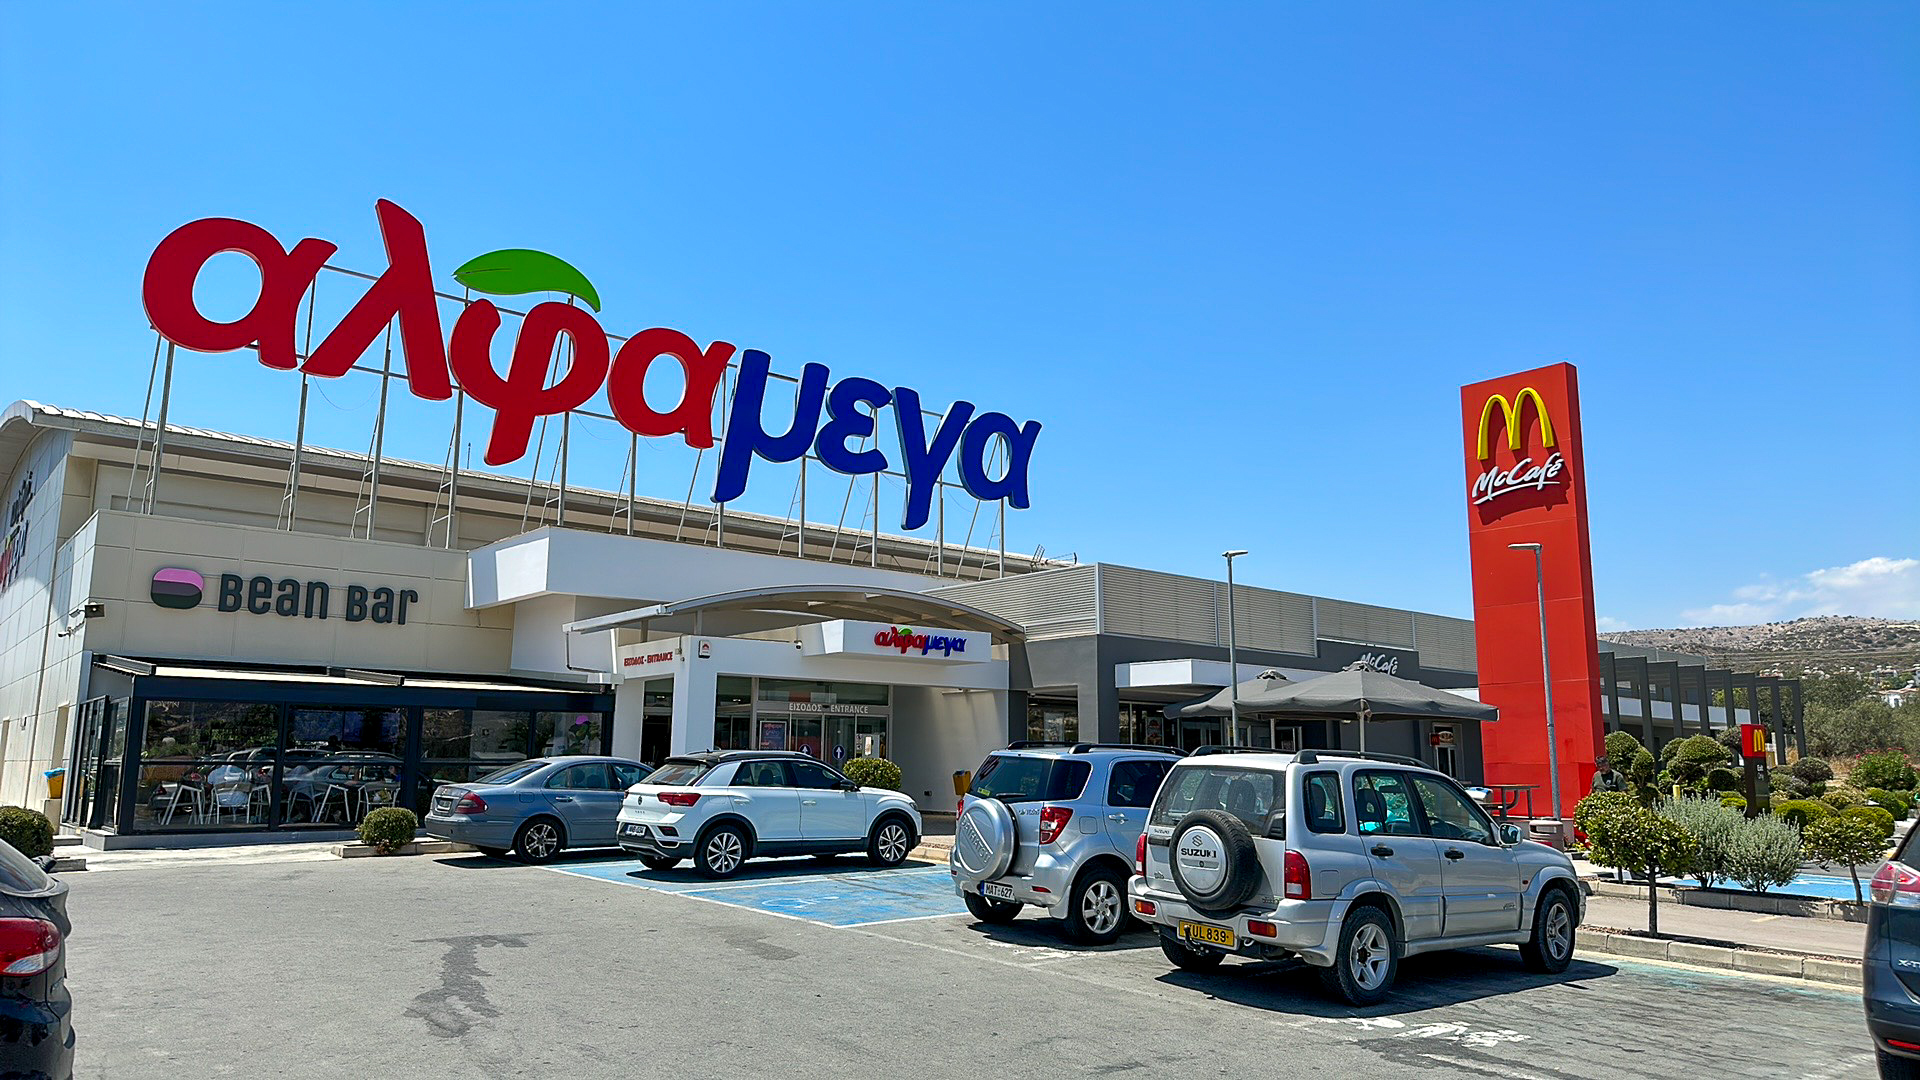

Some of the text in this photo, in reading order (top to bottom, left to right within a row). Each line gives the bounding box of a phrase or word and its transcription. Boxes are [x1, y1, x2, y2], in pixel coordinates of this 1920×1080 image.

[1472, 452, 1564, 501] McCafé
[345, 584, 419, 626] Bar
[788, 702, 869, 714] ΕΙΣΟΔΟΣ ENTRANCE
[1181, 848, 1216, 858] SUZUKI
[1001, 887, 1013, 898] 627
[1206, 928, 1226, 943] 839
